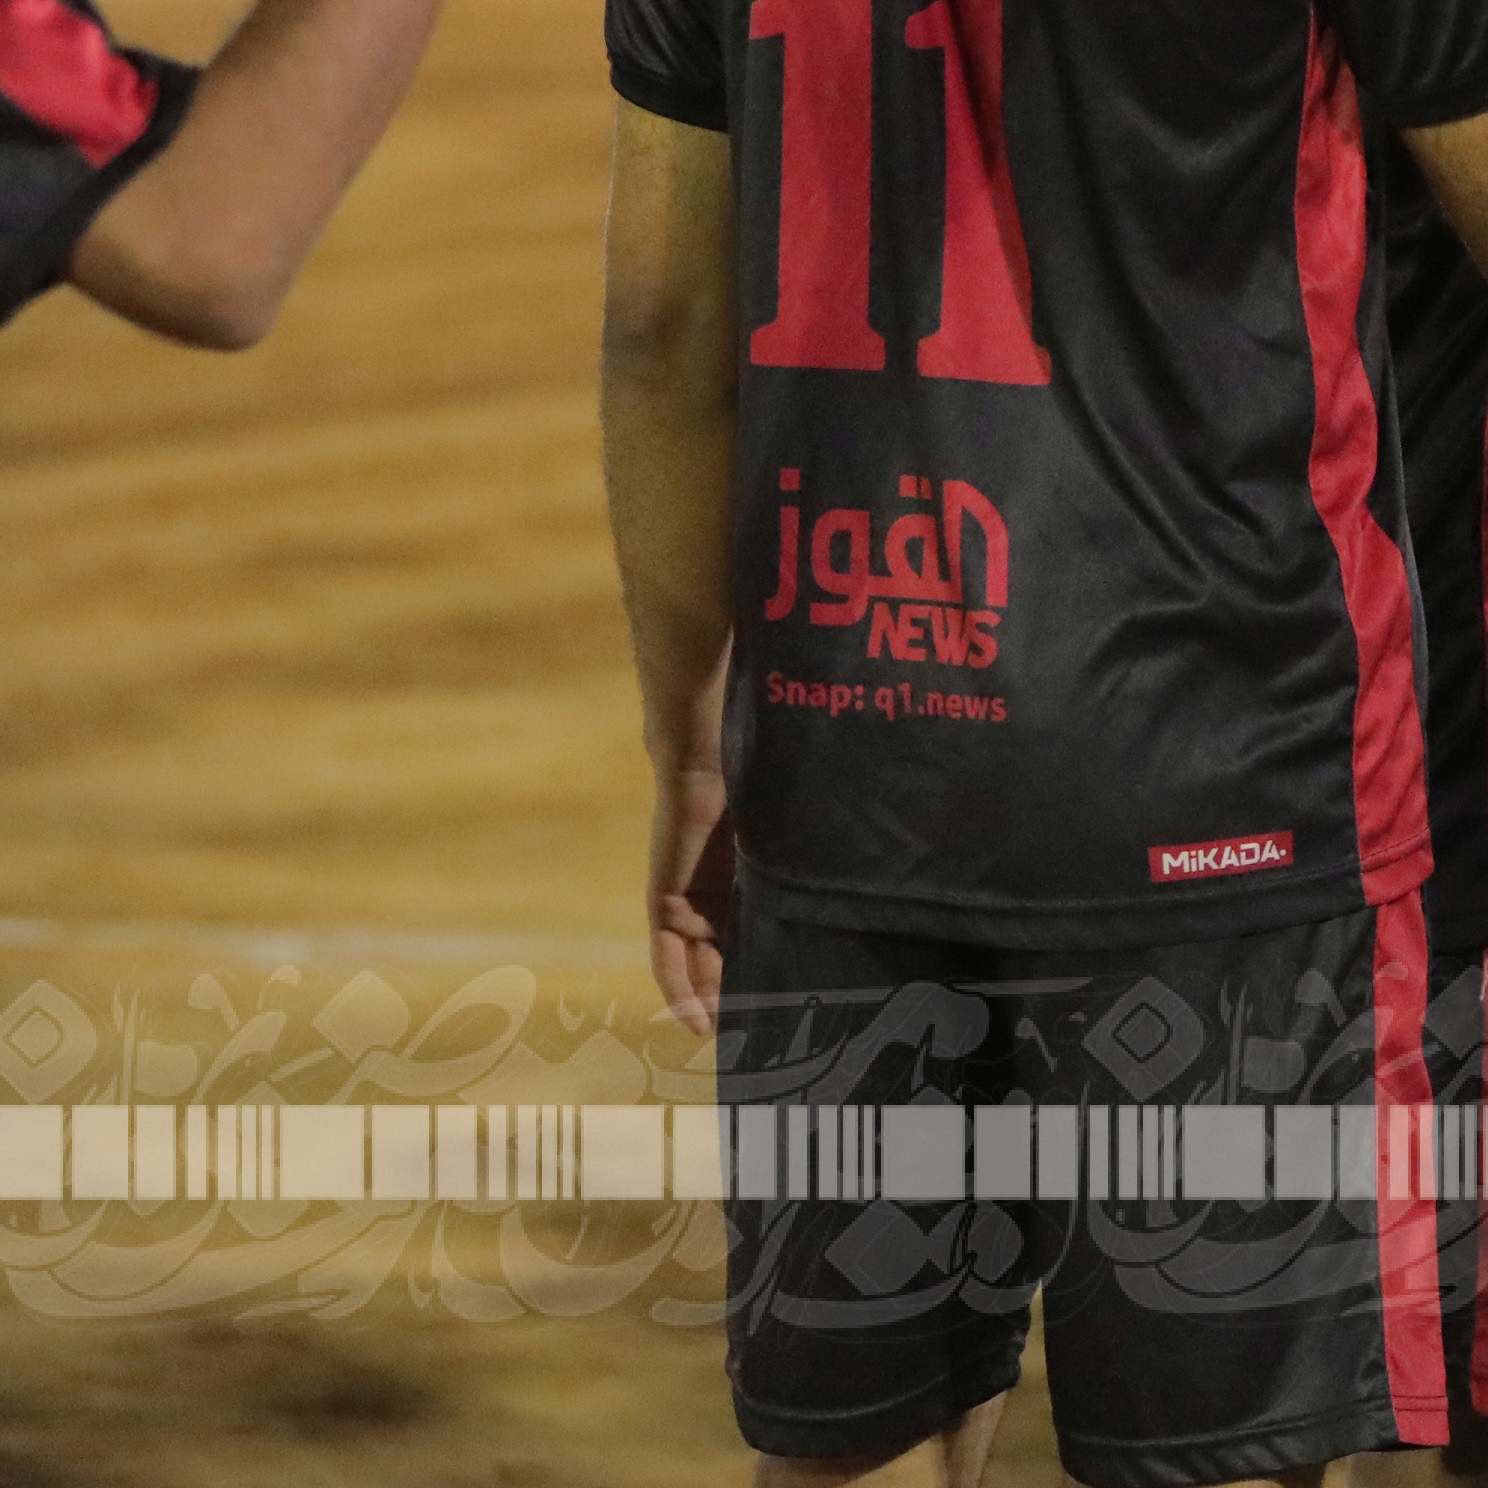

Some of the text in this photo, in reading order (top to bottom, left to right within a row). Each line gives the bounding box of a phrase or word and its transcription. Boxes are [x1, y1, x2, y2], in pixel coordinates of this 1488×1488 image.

[763, 467, 1010, 627] القوز
[866, 601, 1002, 669] NEWS
[766, 671, 1008, 723] Snap: q1.news
